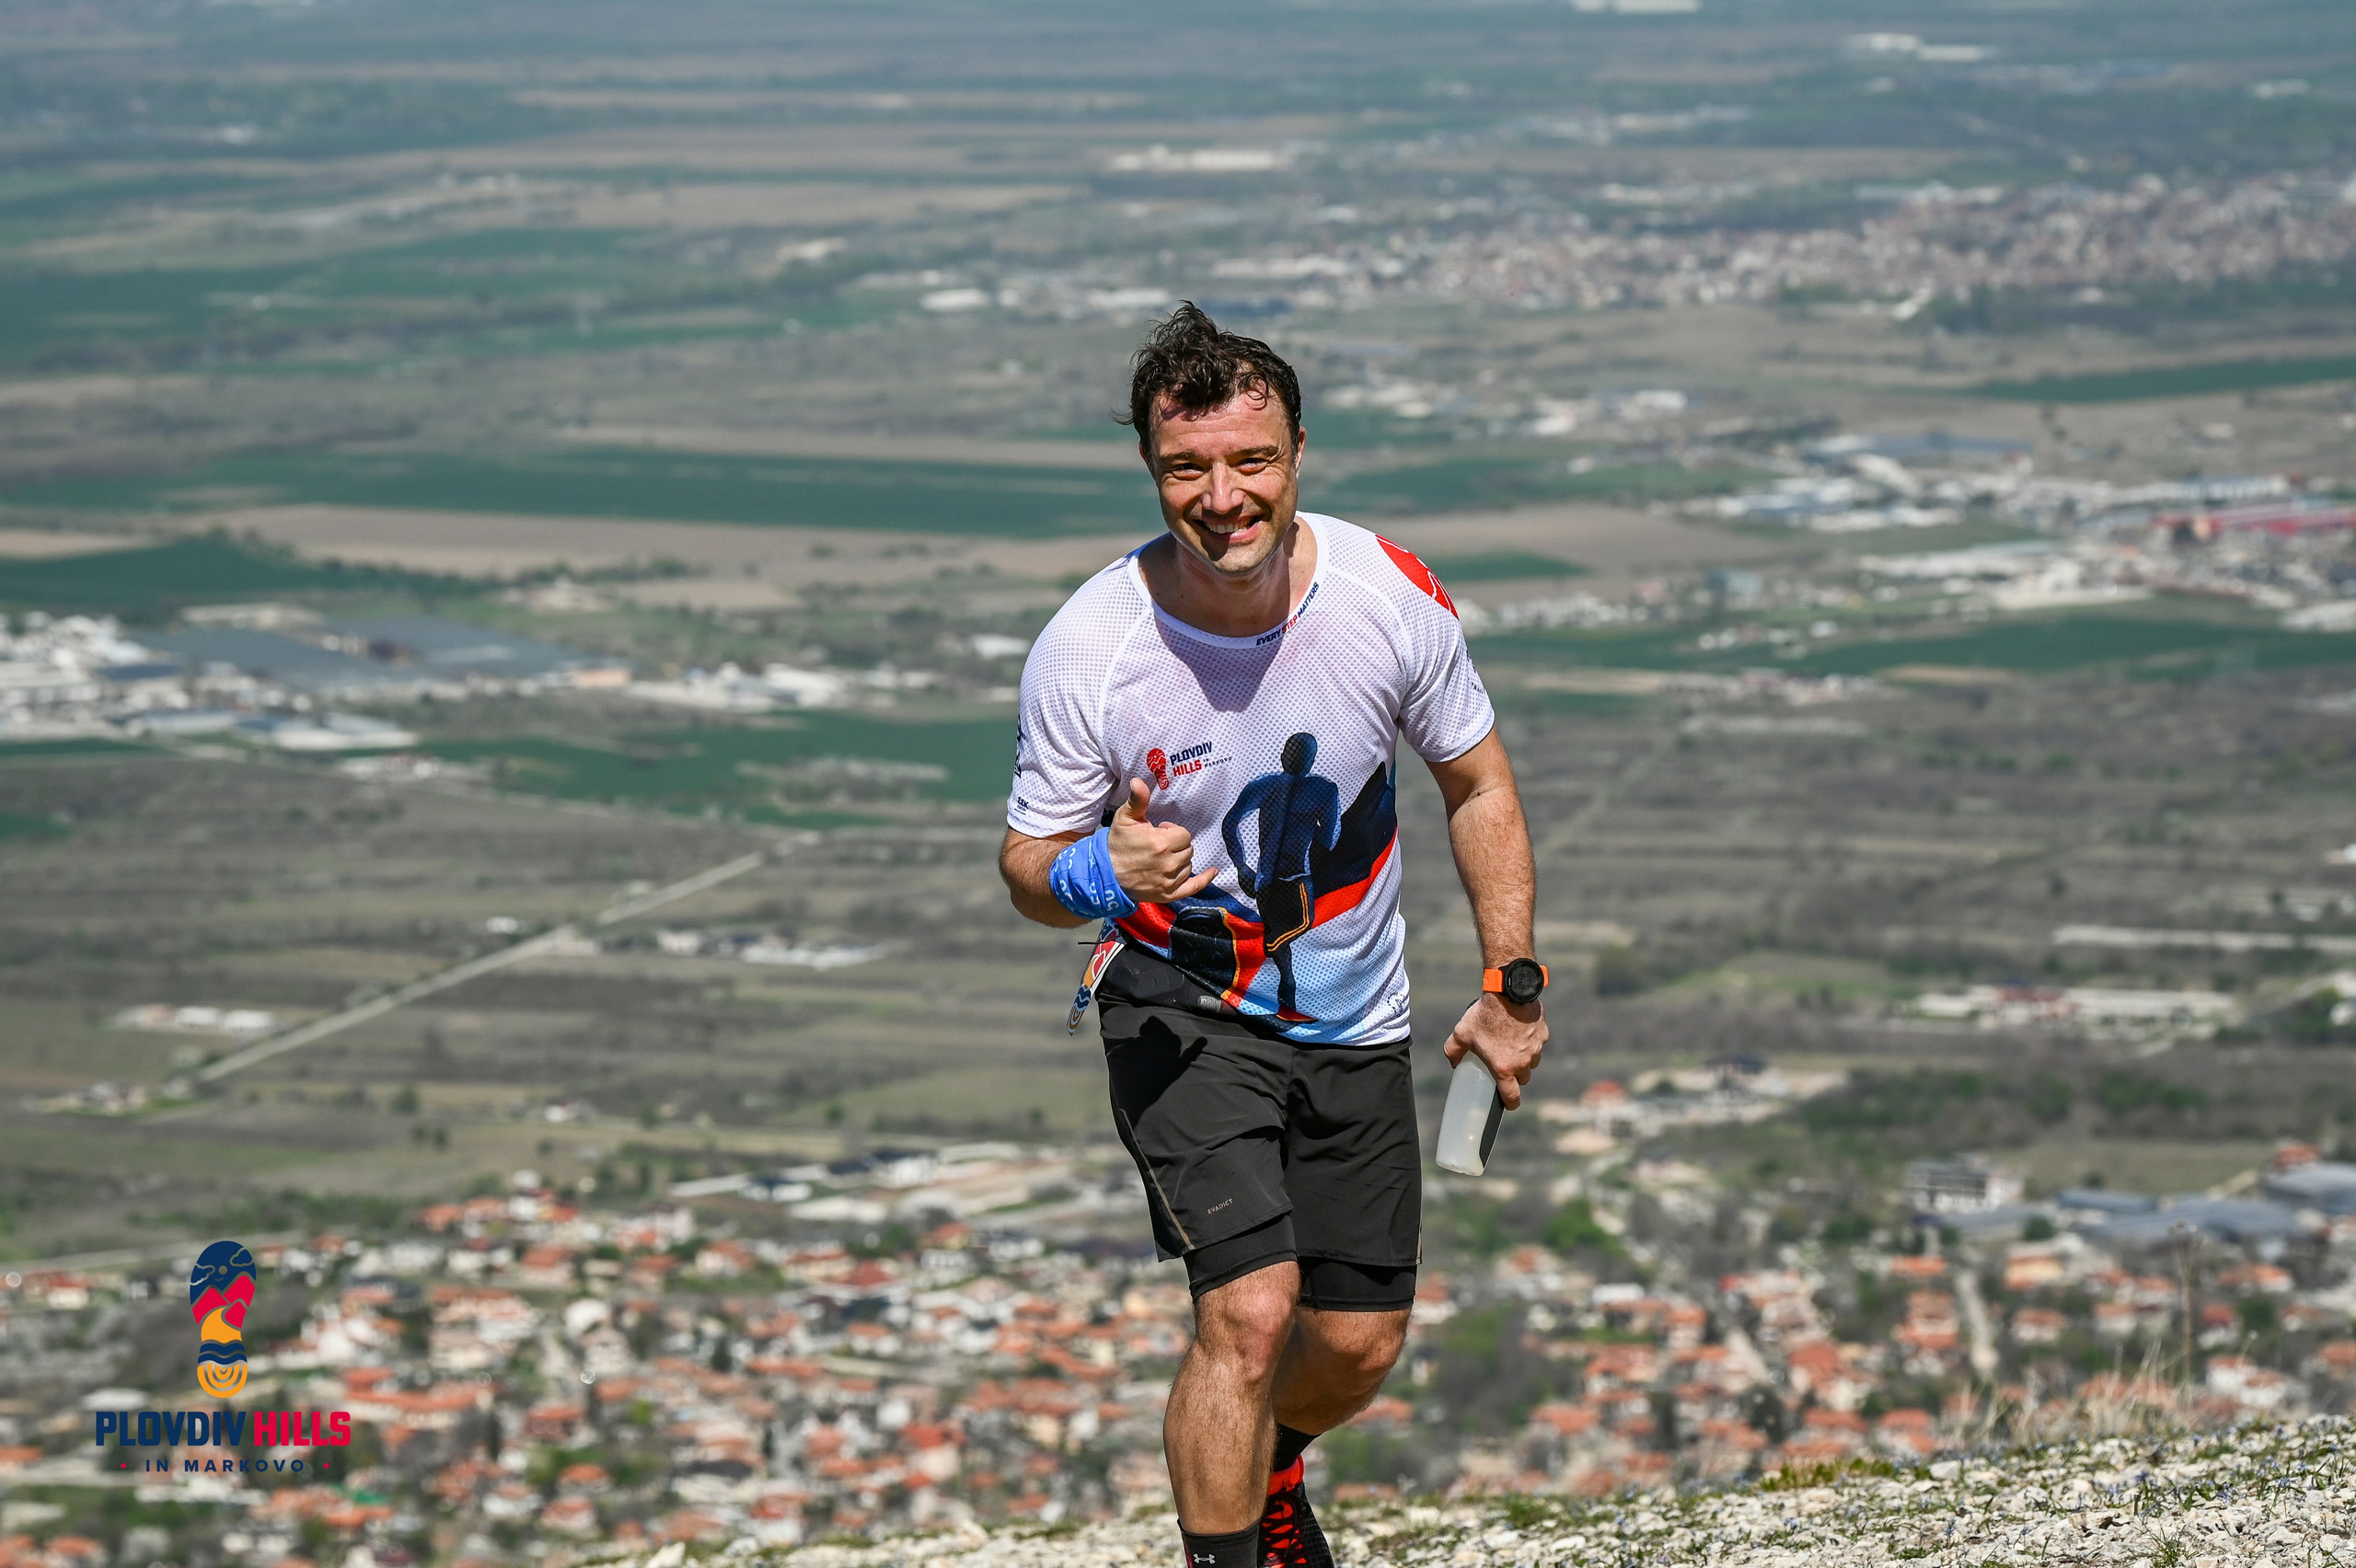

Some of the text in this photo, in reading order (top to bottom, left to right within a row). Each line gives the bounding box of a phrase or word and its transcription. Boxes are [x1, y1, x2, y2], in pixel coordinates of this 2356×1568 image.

[1256, 582, 1320, 646] EVERY STEP MATTERS
[1170, 741, 1213, 766] PLOVDIV
[1204, 756, 1232, 767] MARKOVO
[1172, 759, 1203, 777] HILLS
[1207, 1198, 1233, 1215] EVADICT
